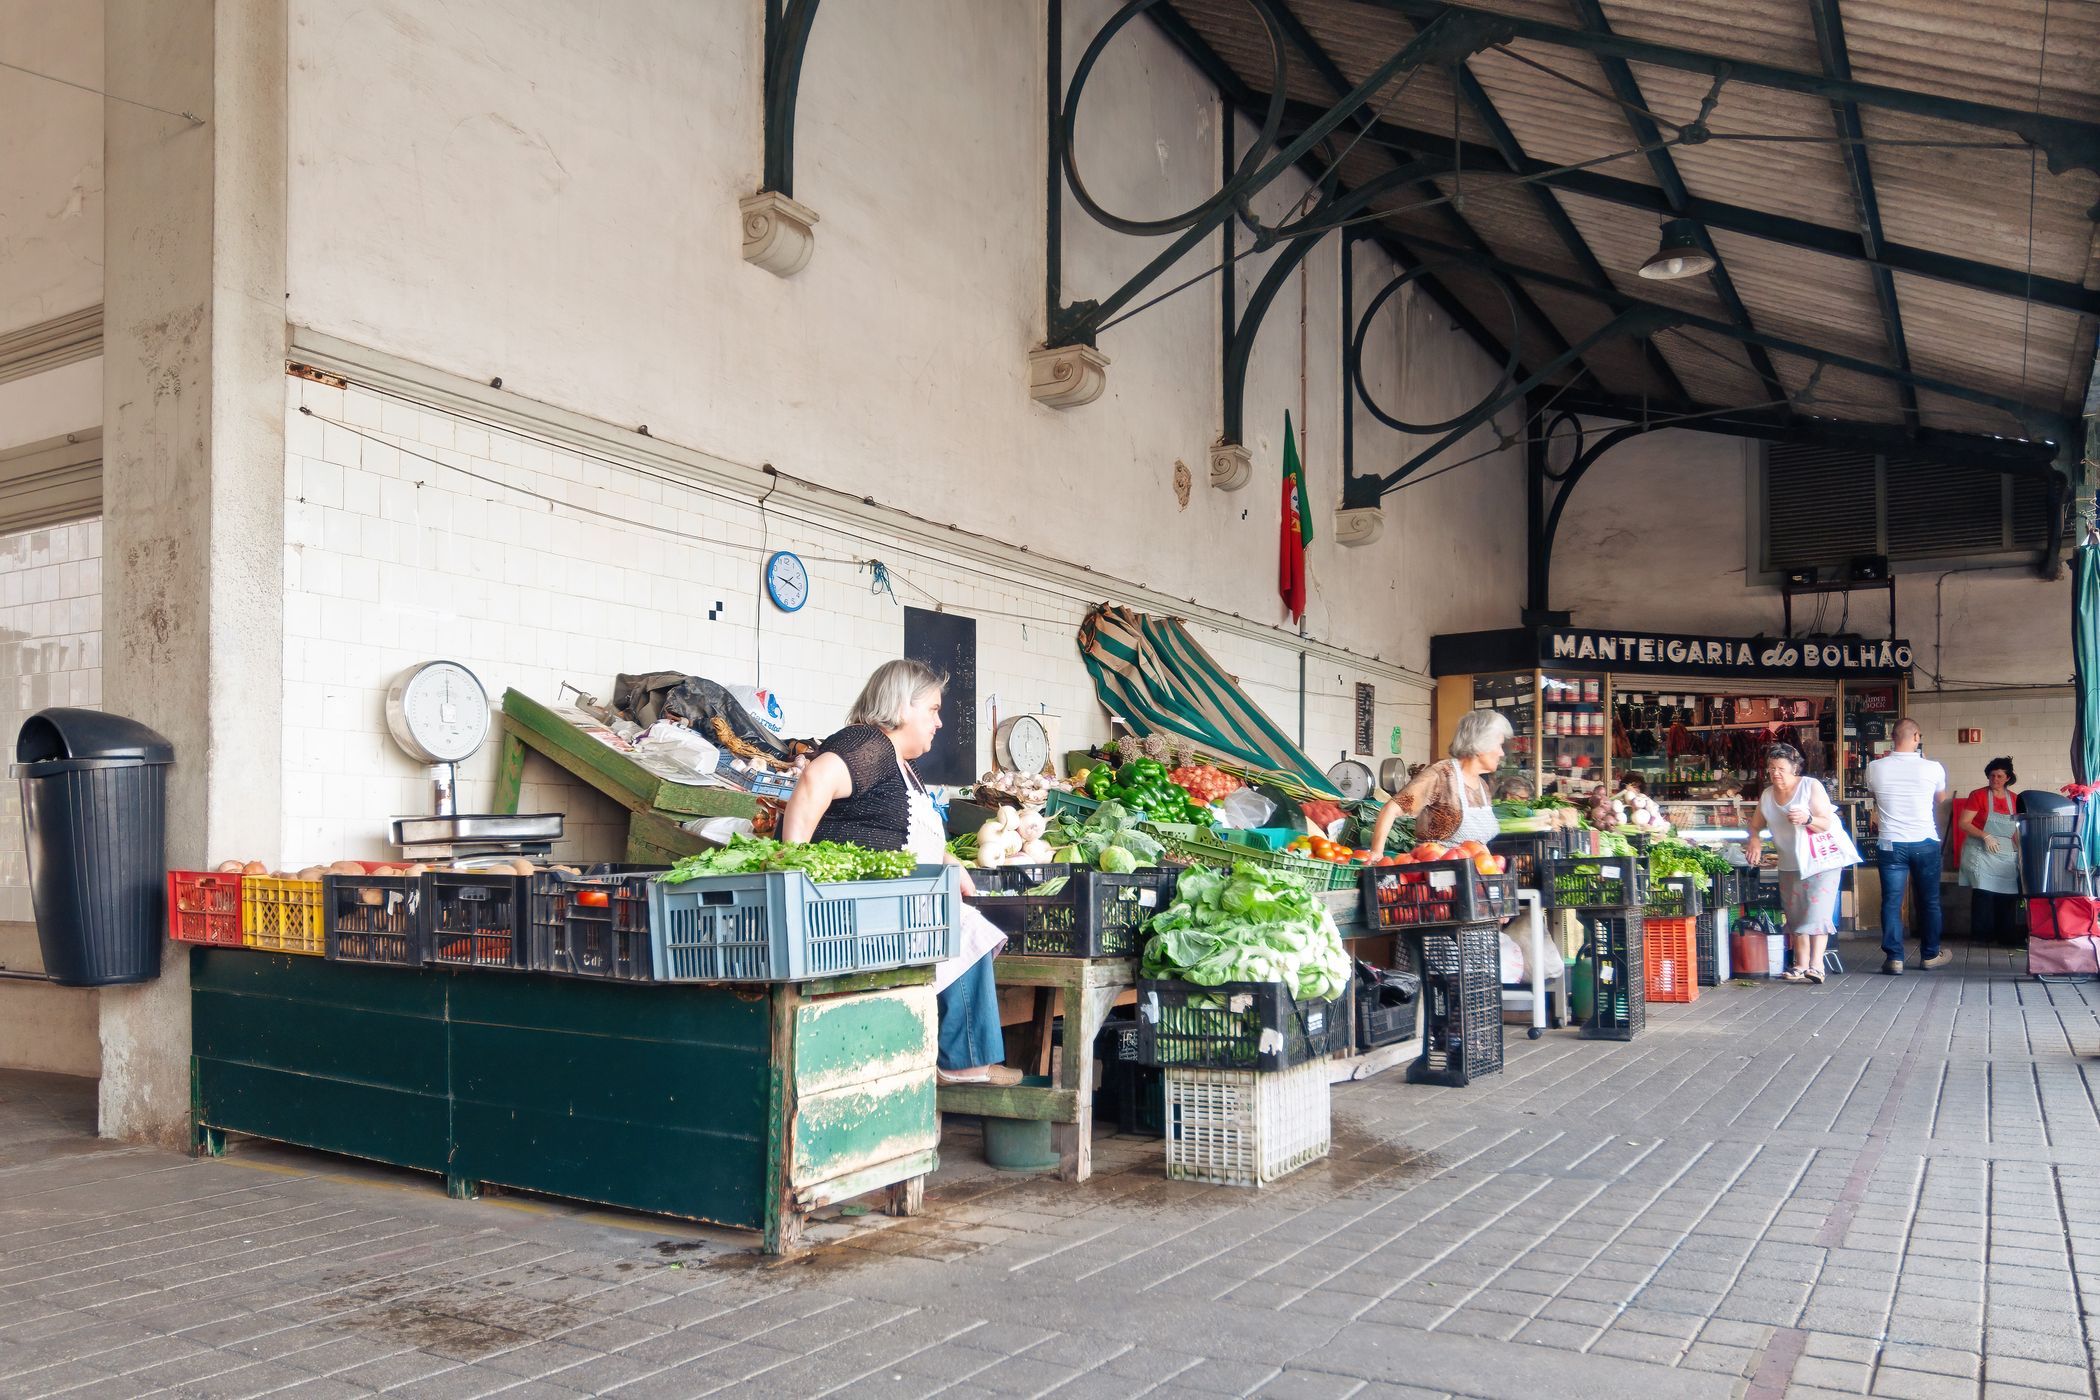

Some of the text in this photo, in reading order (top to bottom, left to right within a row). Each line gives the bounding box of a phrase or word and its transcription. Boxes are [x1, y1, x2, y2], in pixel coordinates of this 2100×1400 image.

[1553, 634, 1913, 668] MANTEIGARIA do BOLHÃO
